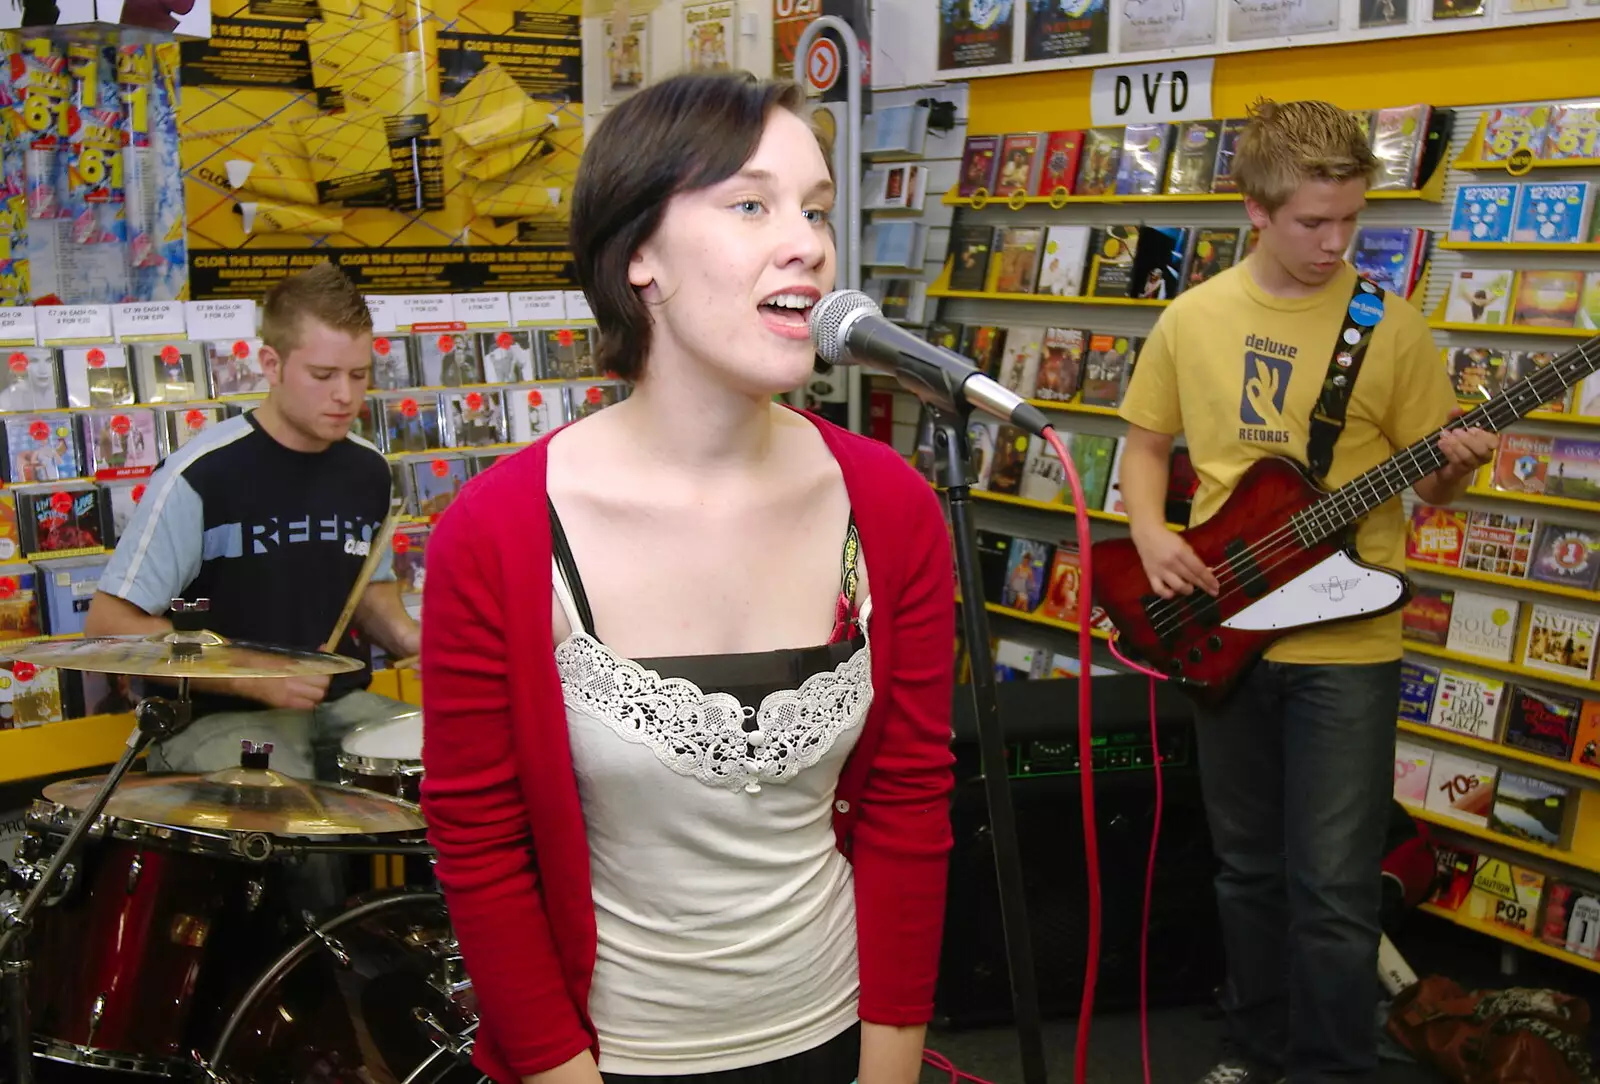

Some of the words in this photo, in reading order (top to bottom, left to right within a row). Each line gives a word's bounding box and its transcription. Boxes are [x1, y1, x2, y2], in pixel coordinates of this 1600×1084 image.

[1114, 70, 1189, 116] DVD
[24, 95, 69, 137] 61
[79, 149, 123, 189] 61
[194, 256, 228, 268] CLOR
[228, 256, 250, 267] THE
[251, 255, 288, 267] DEBUT
[340, 254, 369, 265] CLOR
[370, 253, 391, 264] THE
[392, 253, 427, 264] DEBUT
[428, 252, 465, 263] ALBUM
[1245, 333, 1298, 359] deluxe
[1238, 427, 1290, 443] RECORDS
[1451, 612, 1508, 640] SOUL
[1534, 611, 1595, 637] SIXTIES
[1448, 631, 1508, 650] LEGENDS
[1450, 695, 1485, 719] TRAD
[1439, 773, 1480, 804] 70s
[1477, 875, 1511, 895] CAUTION
[1495, 900, 1528, 921] POP
